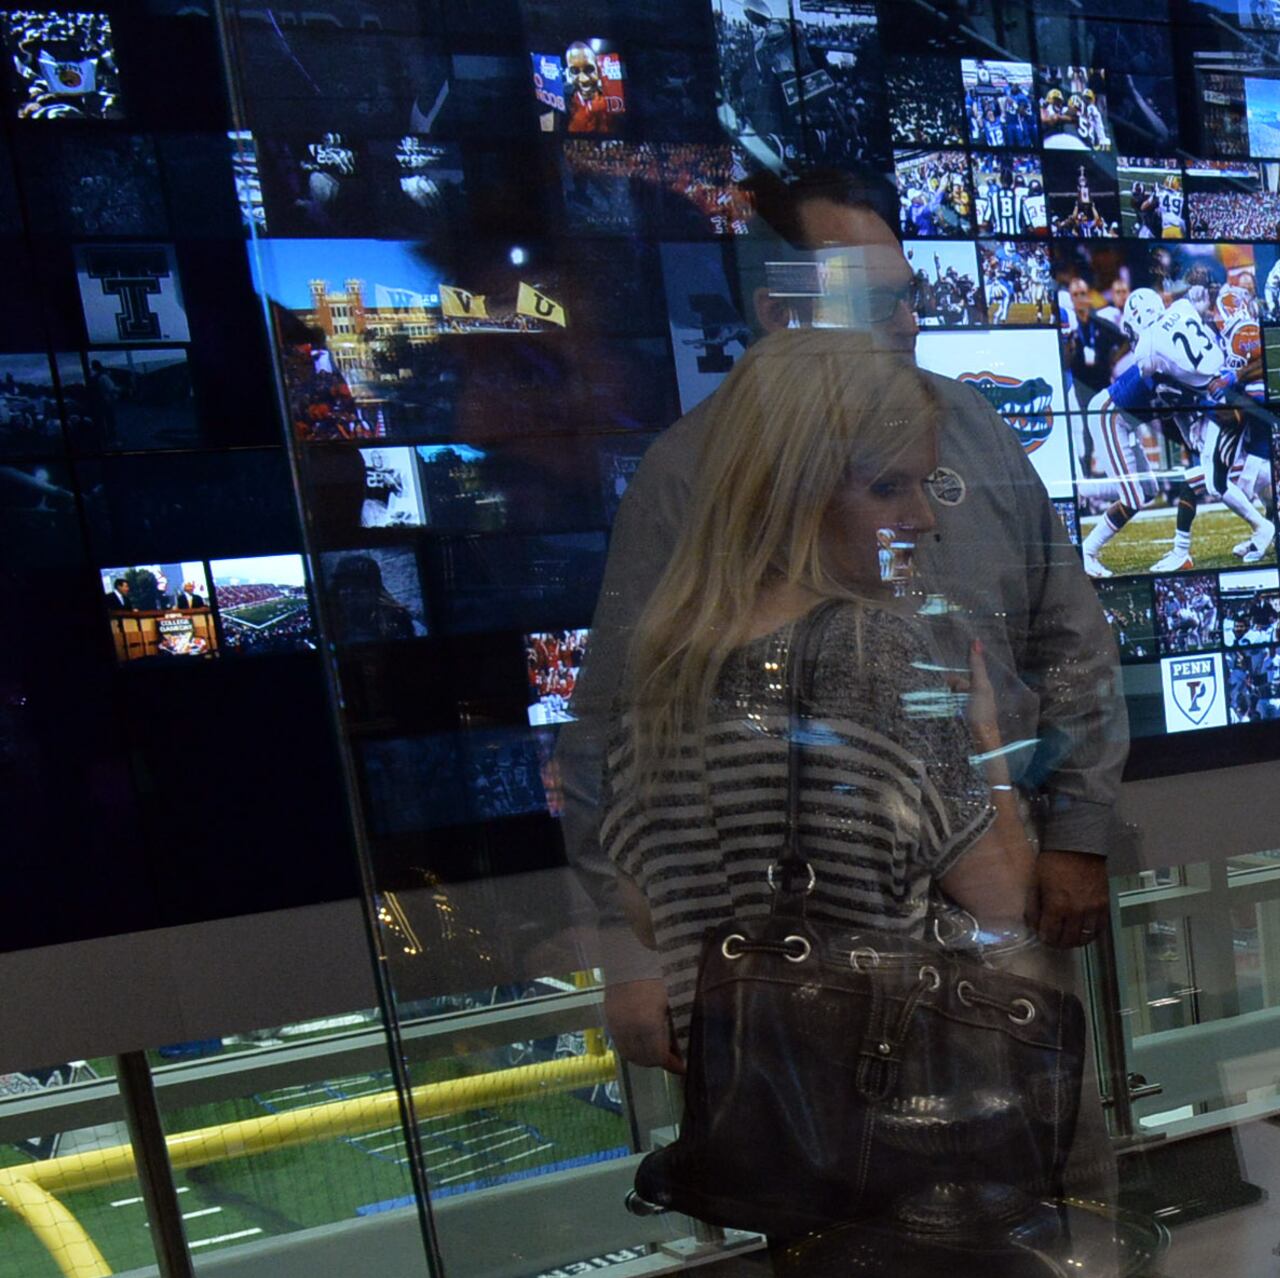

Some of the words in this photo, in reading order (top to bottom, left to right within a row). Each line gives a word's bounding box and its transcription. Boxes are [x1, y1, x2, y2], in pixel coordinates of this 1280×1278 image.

[1162, 194, 1181, 215] 49
[534, 293, 556, 316] U
[1172, 318, 1213, 371] 23
[1172, 661, 1211, 676] PENN
